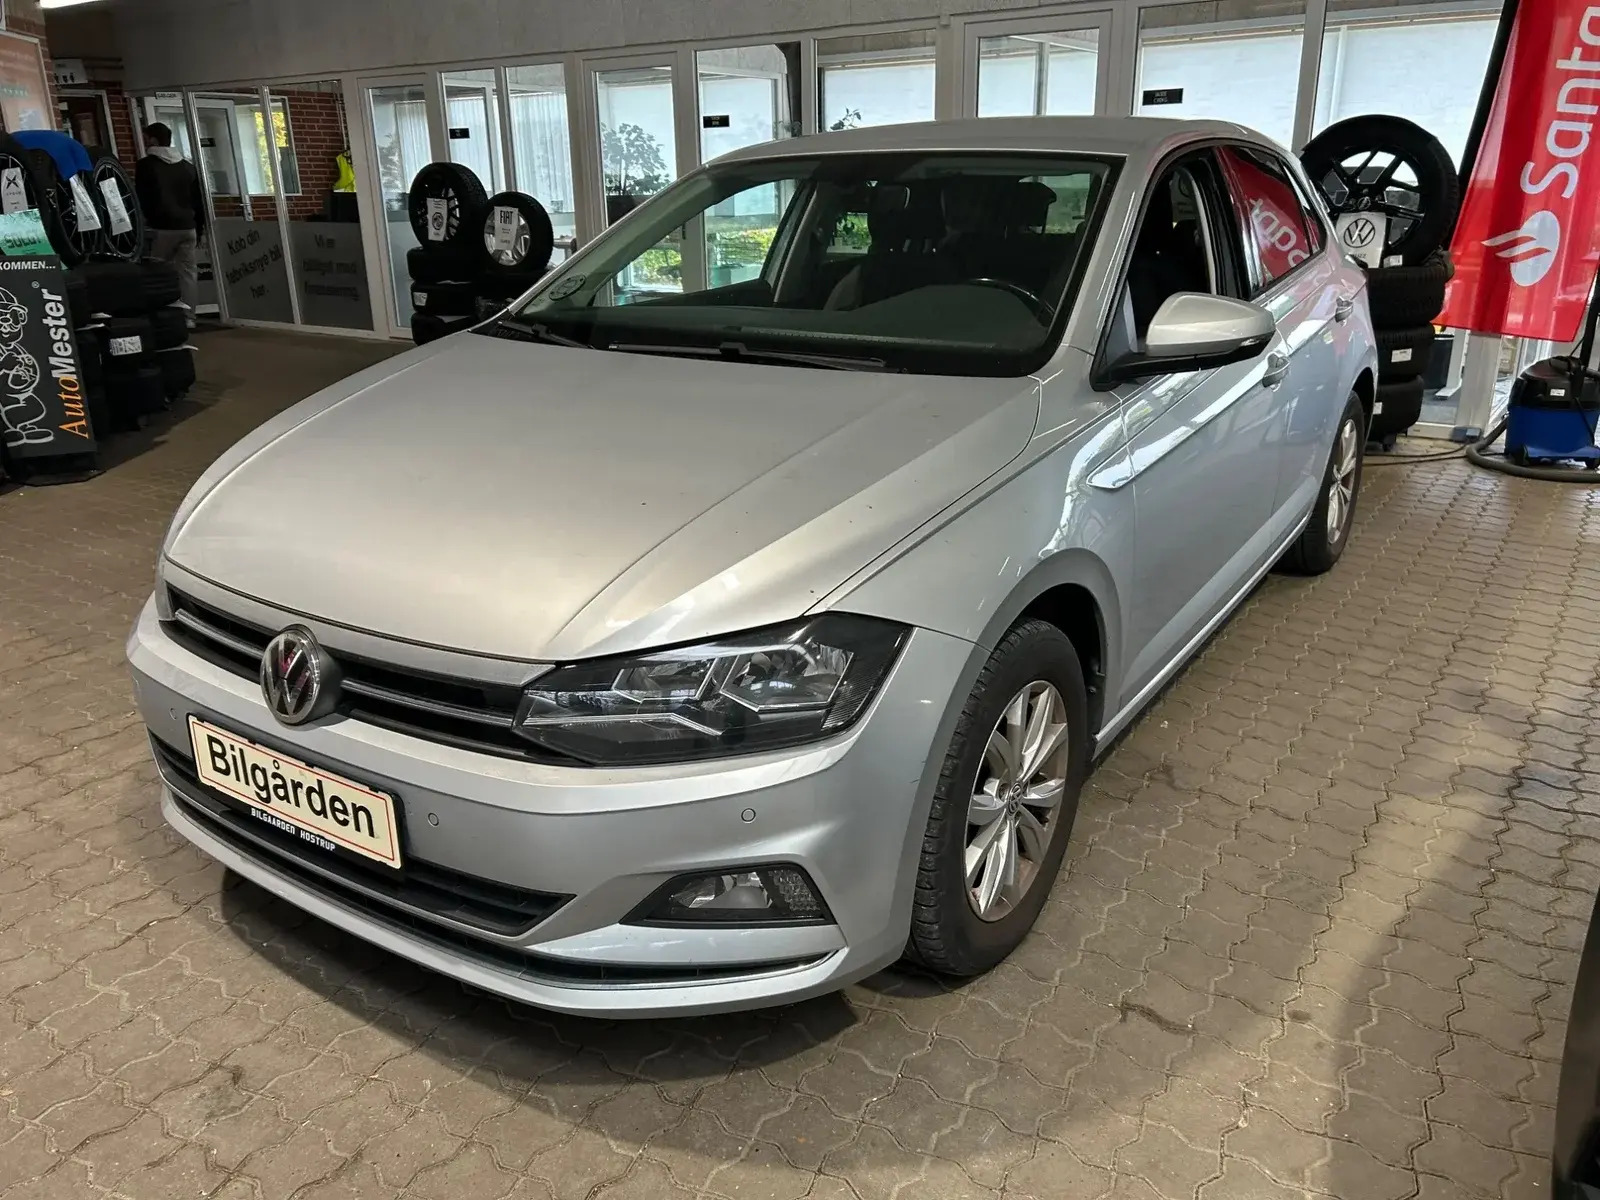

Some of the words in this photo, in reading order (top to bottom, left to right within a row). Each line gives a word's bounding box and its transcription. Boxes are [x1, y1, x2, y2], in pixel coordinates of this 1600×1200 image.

[500, 210, 513, 225] FIAT
[41, 288, 89, 439] AutoMester
[206, 733, 375, 839] Bilgården
[251, 807, 295, 835] BILGAARDEN
[300, 829, 336, 852] HOSTRUP
